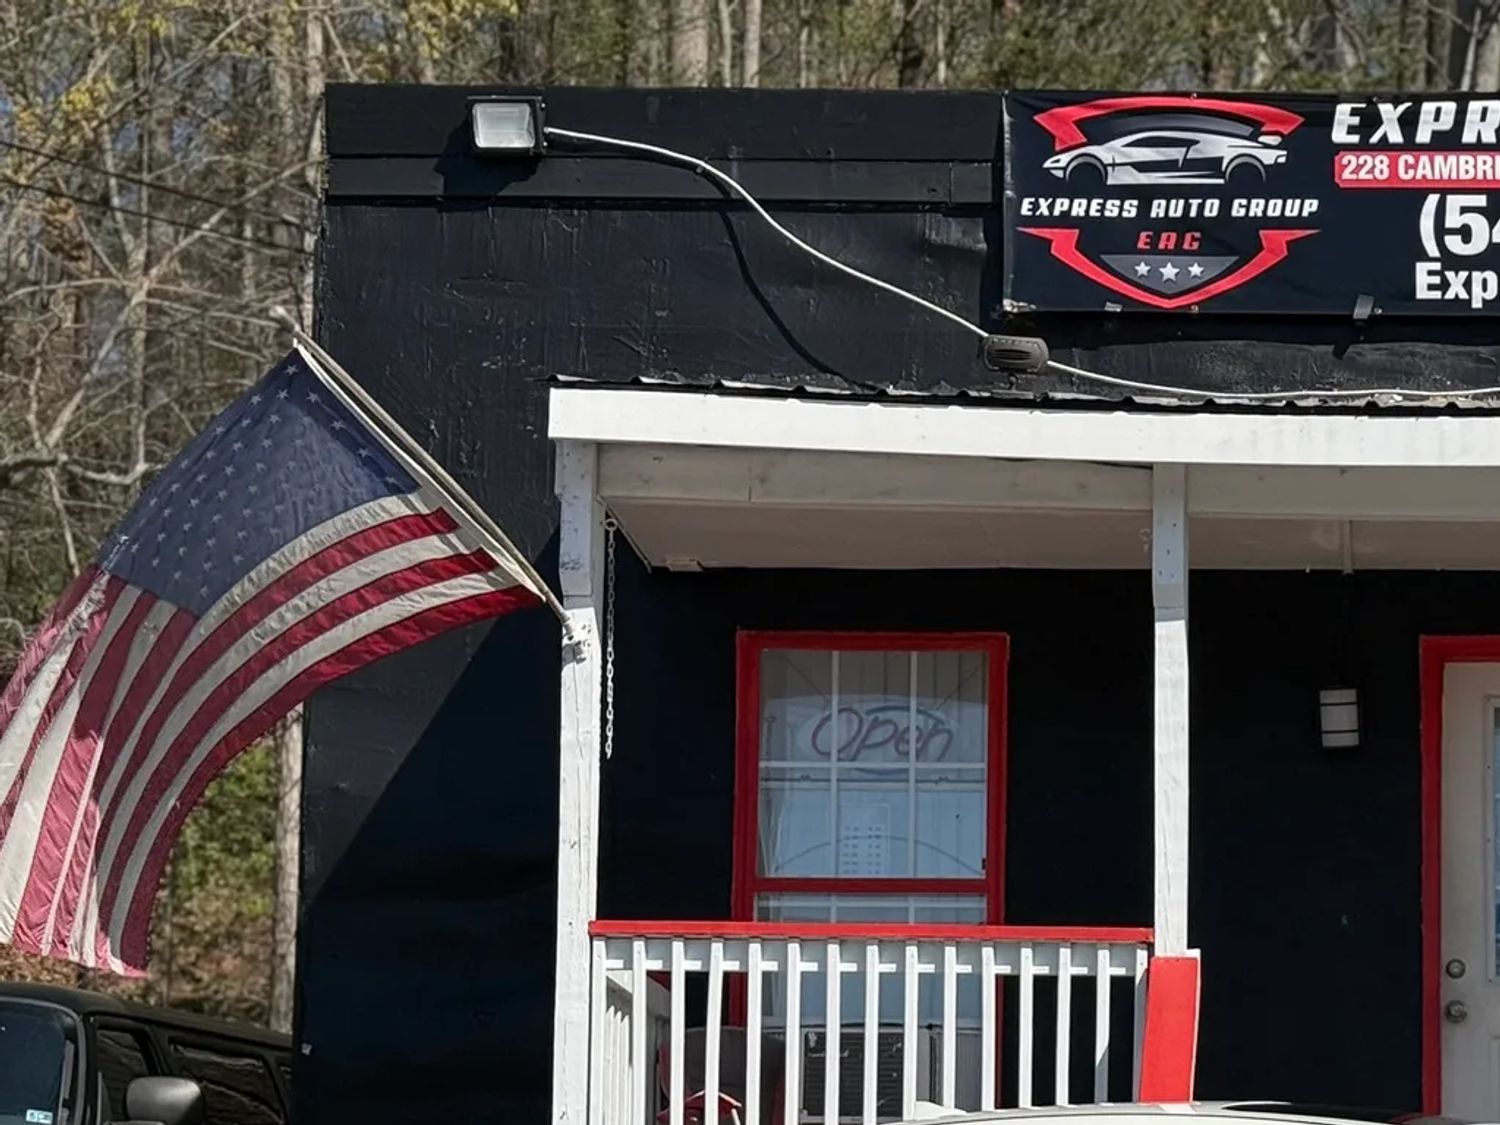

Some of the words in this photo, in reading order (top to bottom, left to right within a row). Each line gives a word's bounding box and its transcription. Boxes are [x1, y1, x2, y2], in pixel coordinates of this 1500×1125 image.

[1340, 156, 1391, 182] 228
[1020, 197, 1139, 218] EXPRESS
[1150, 198, 1220, 218] AUTO
[1231, 198, 1319, 218] GROUP
[1137, 231, 1201, 250] EAG
